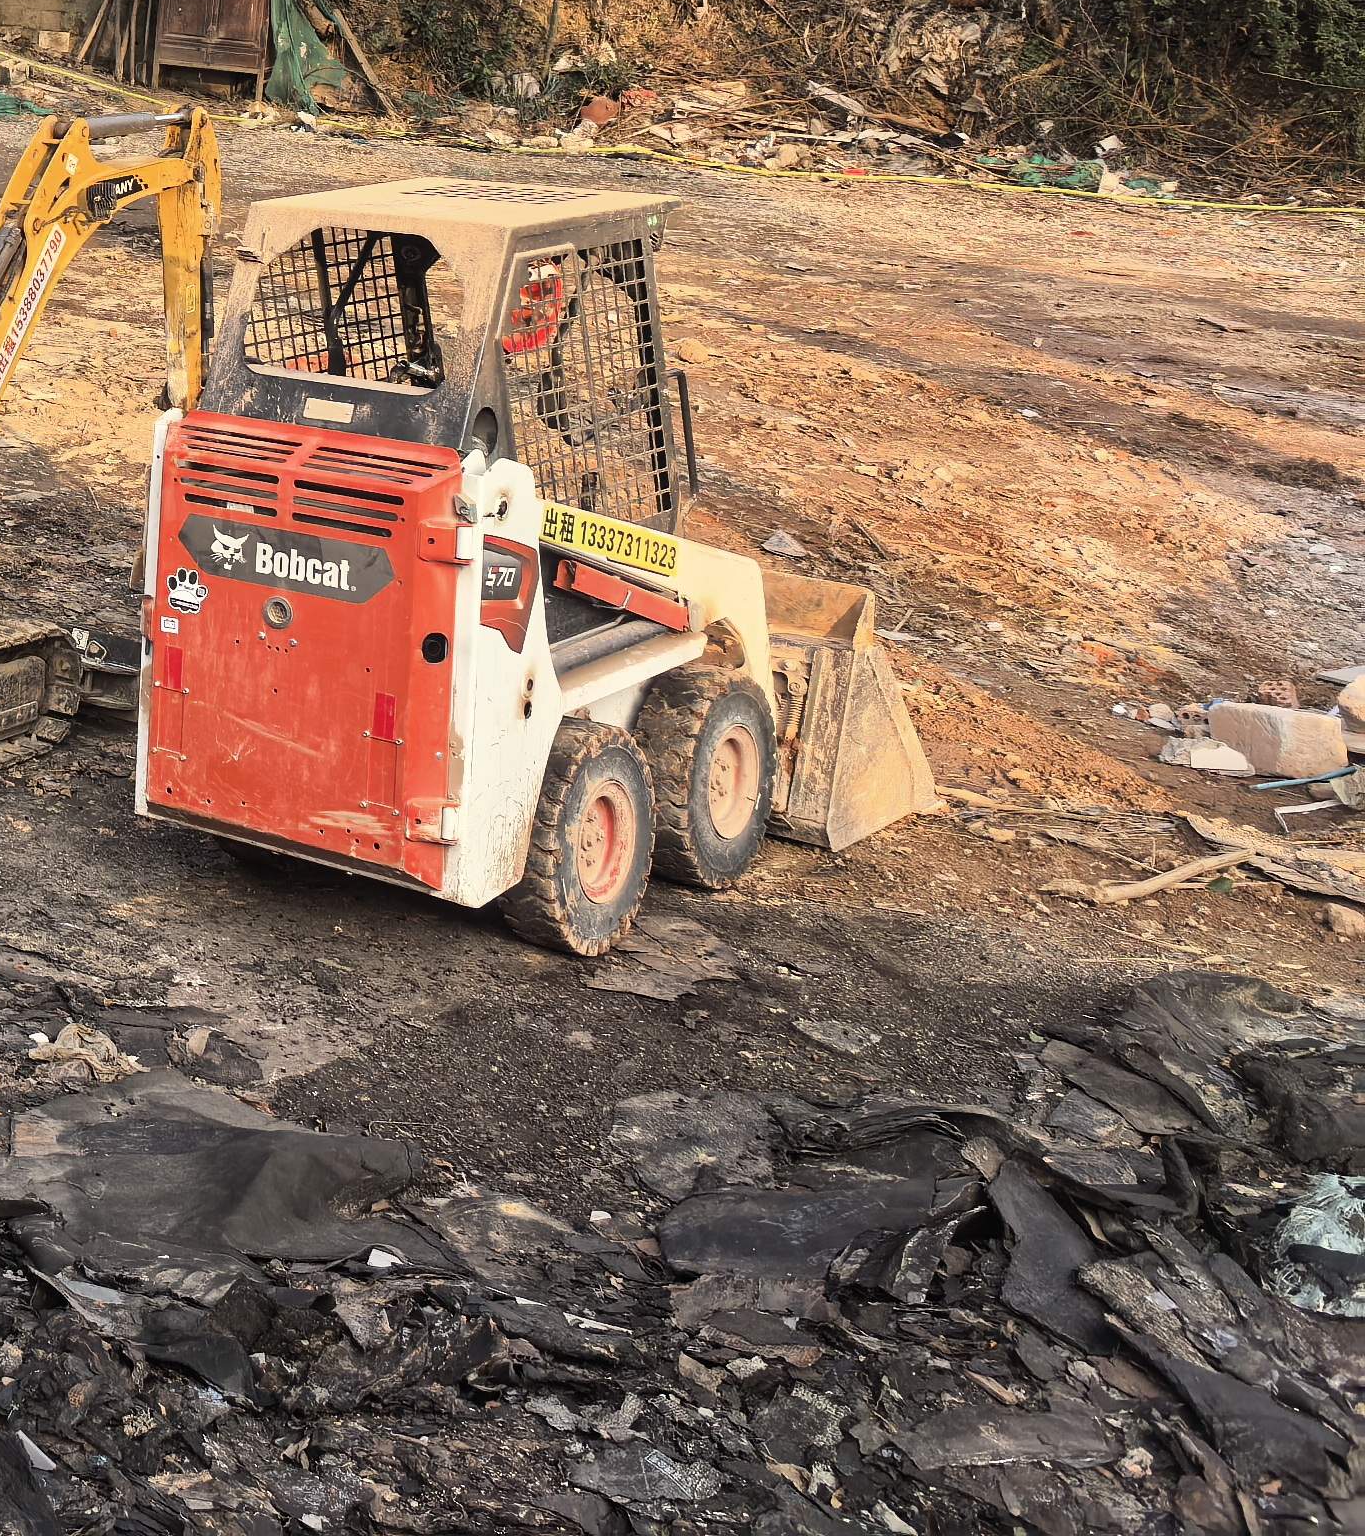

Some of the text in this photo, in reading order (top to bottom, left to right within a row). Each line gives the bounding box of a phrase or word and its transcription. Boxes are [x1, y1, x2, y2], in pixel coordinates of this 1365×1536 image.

[114, 178, 135, 196] ANY
[543, 507, 677, 570] 出租 13337311323
[255, 542, 351, 591] Bobcat
